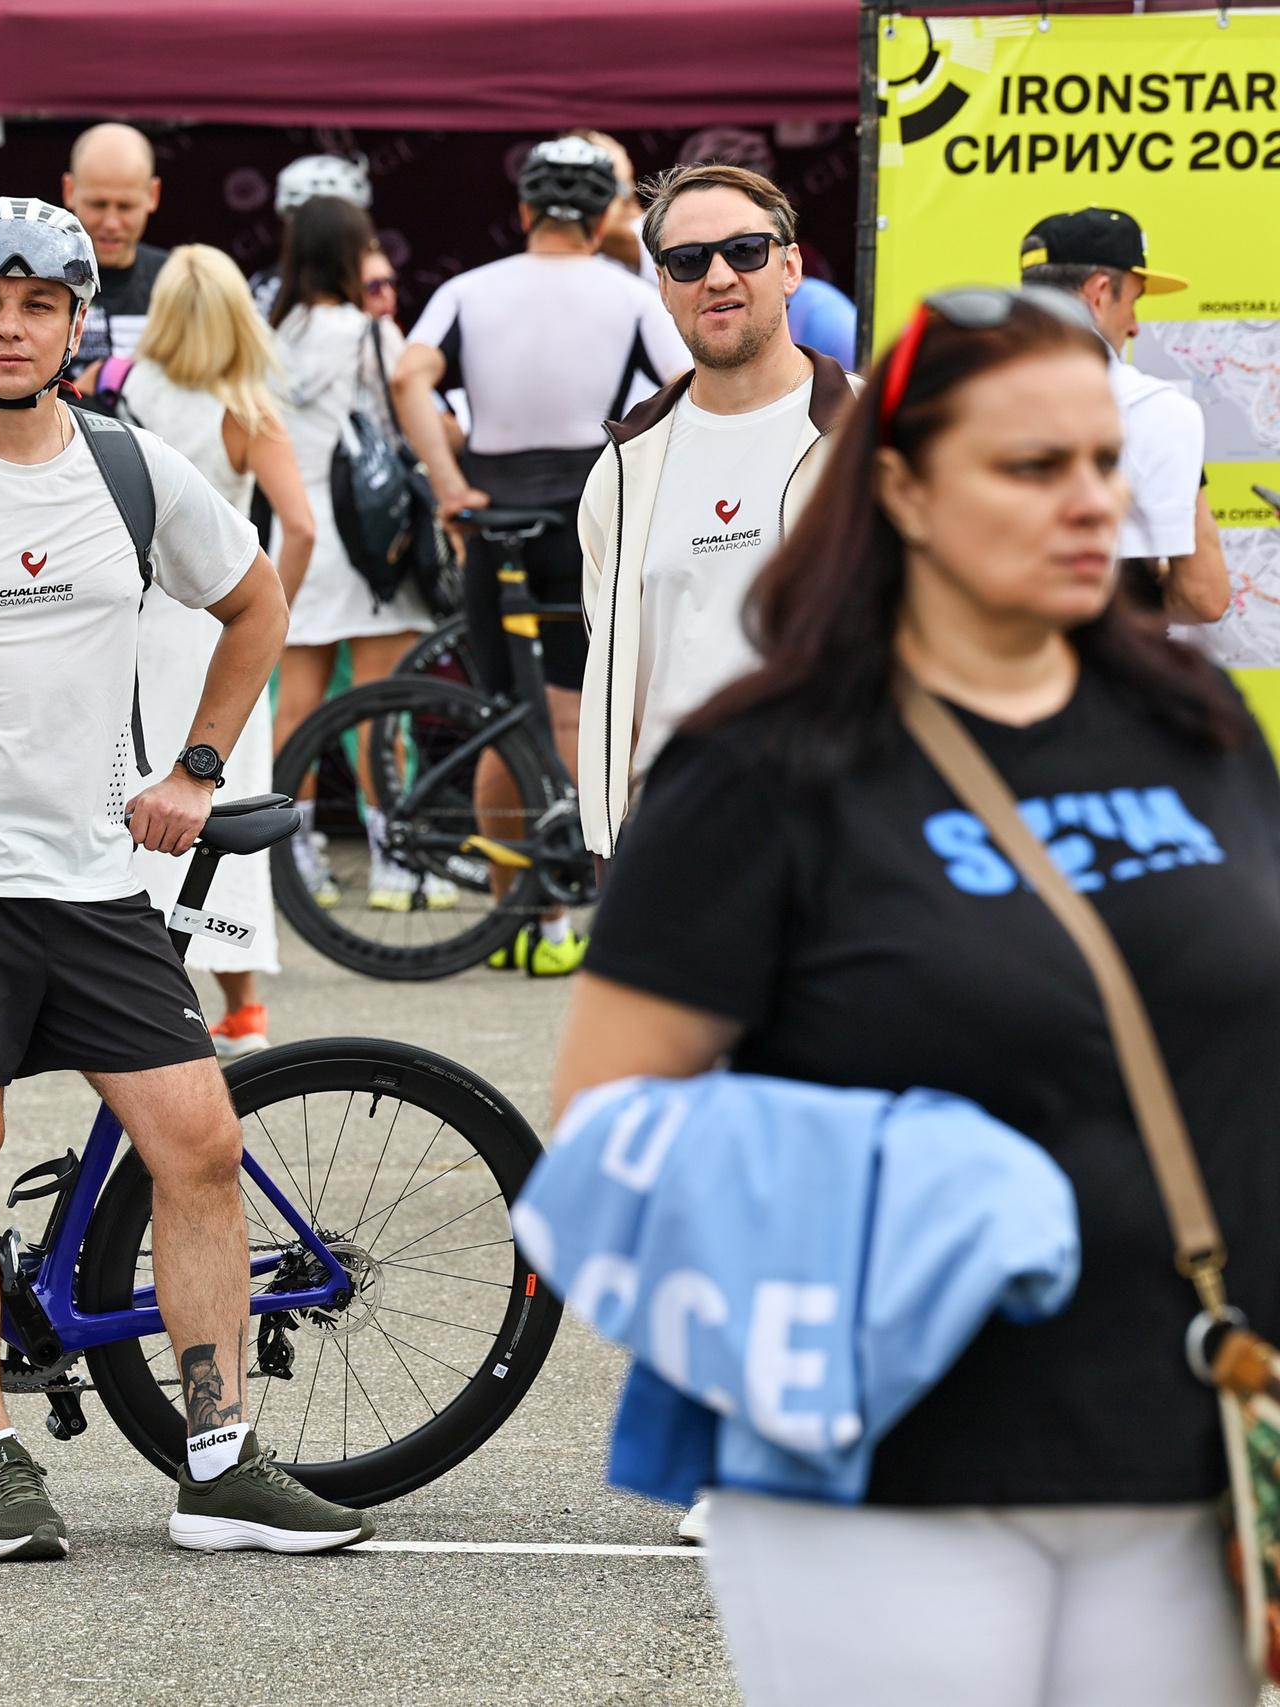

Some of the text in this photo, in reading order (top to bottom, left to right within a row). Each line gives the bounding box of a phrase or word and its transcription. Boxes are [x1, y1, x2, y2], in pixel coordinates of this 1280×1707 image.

[1000, 72, 1277, 115] IRONSTAR
[944, 131, 1175, 176] СИРИУС
[692, 528, 761, 546] CHALLENGE
[692, 538, 761, 555] SAMARKAND
[0, 583, 73, 598] CHALLENGE
[0, 593, 74, 607] SAMARKAND
[204, 917, 249, 940] 1397
[189, 1431, 238, 1452] adidas
